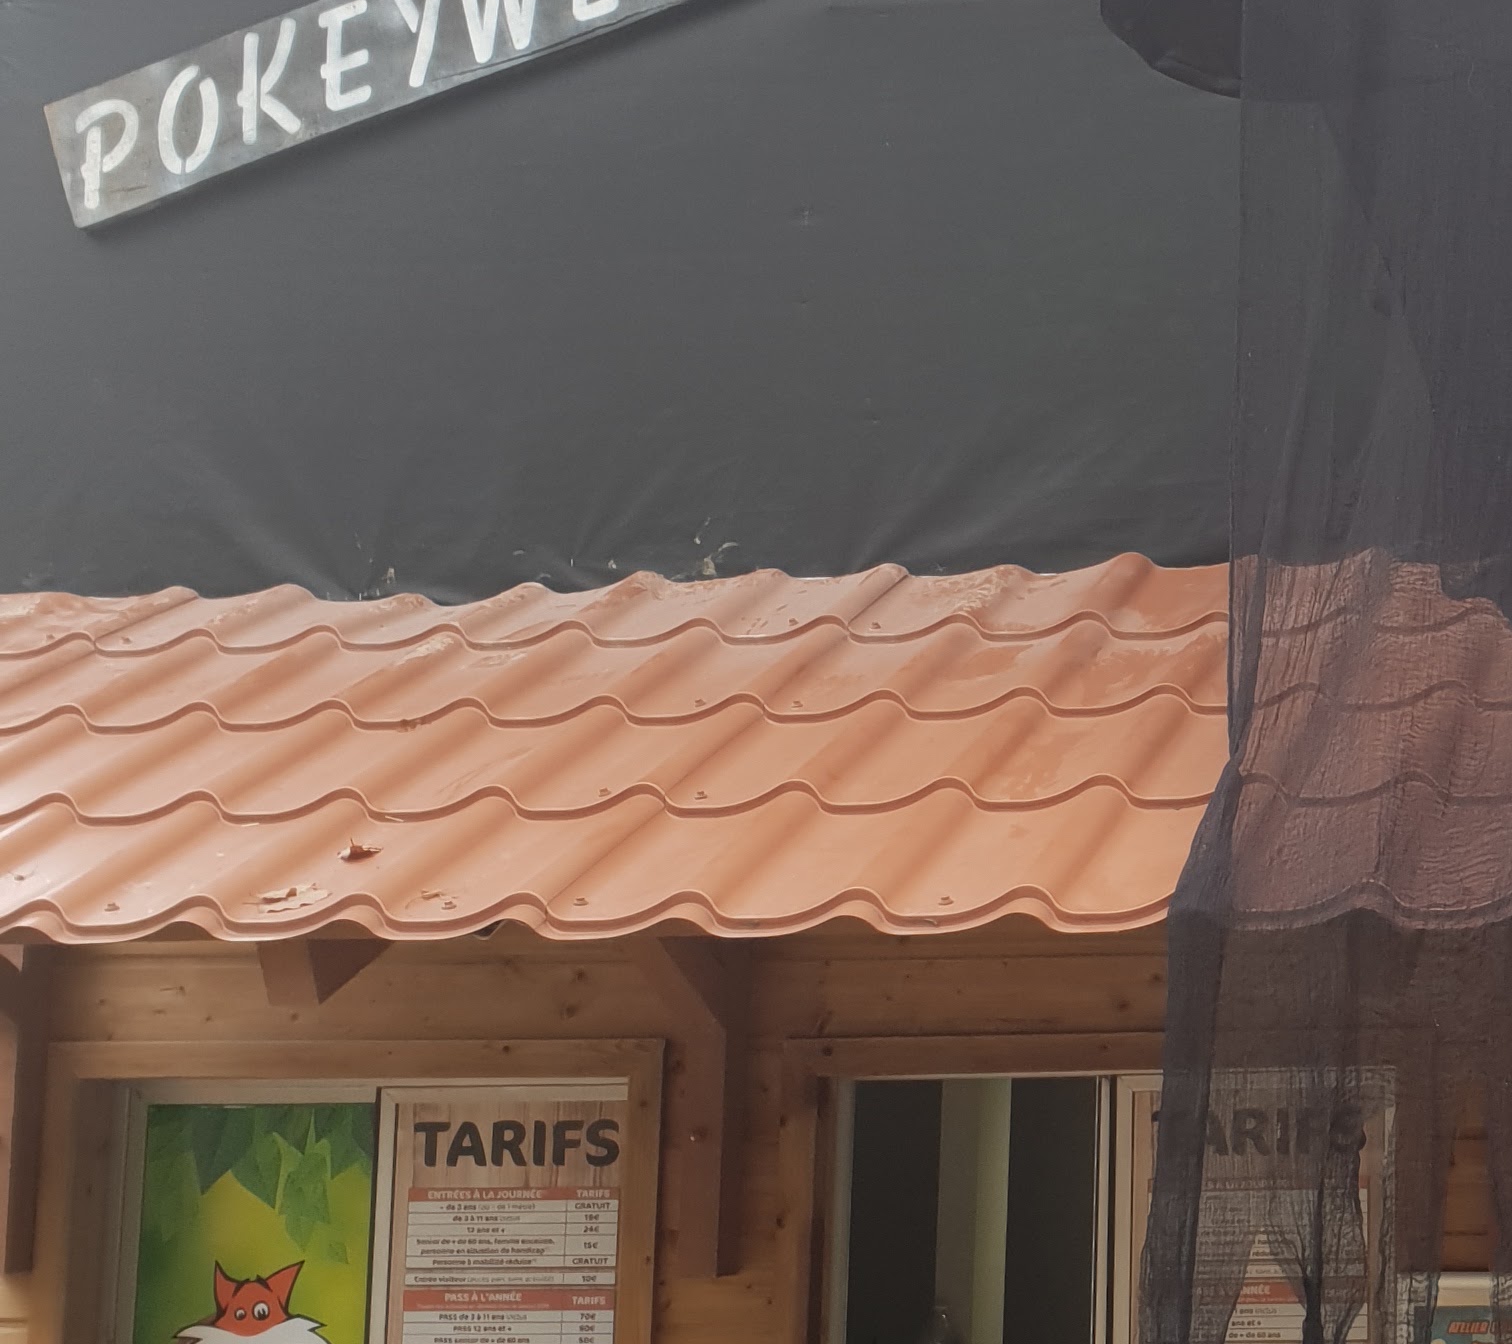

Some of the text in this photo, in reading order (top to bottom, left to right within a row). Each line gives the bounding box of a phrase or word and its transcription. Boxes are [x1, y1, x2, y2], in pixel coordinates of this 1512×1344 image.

[414, 1119, 620, 1167] TARIFS
[428, 1190, 471, 1199] ENTRÉES
[483, 1190, 494, 1198] LA
[497, 1189, 541, 1199] JOURNÉE
[481, 1292, 521, 1301] L'ANNÉE
[572, 1296, 605, 1305] TARIFS
